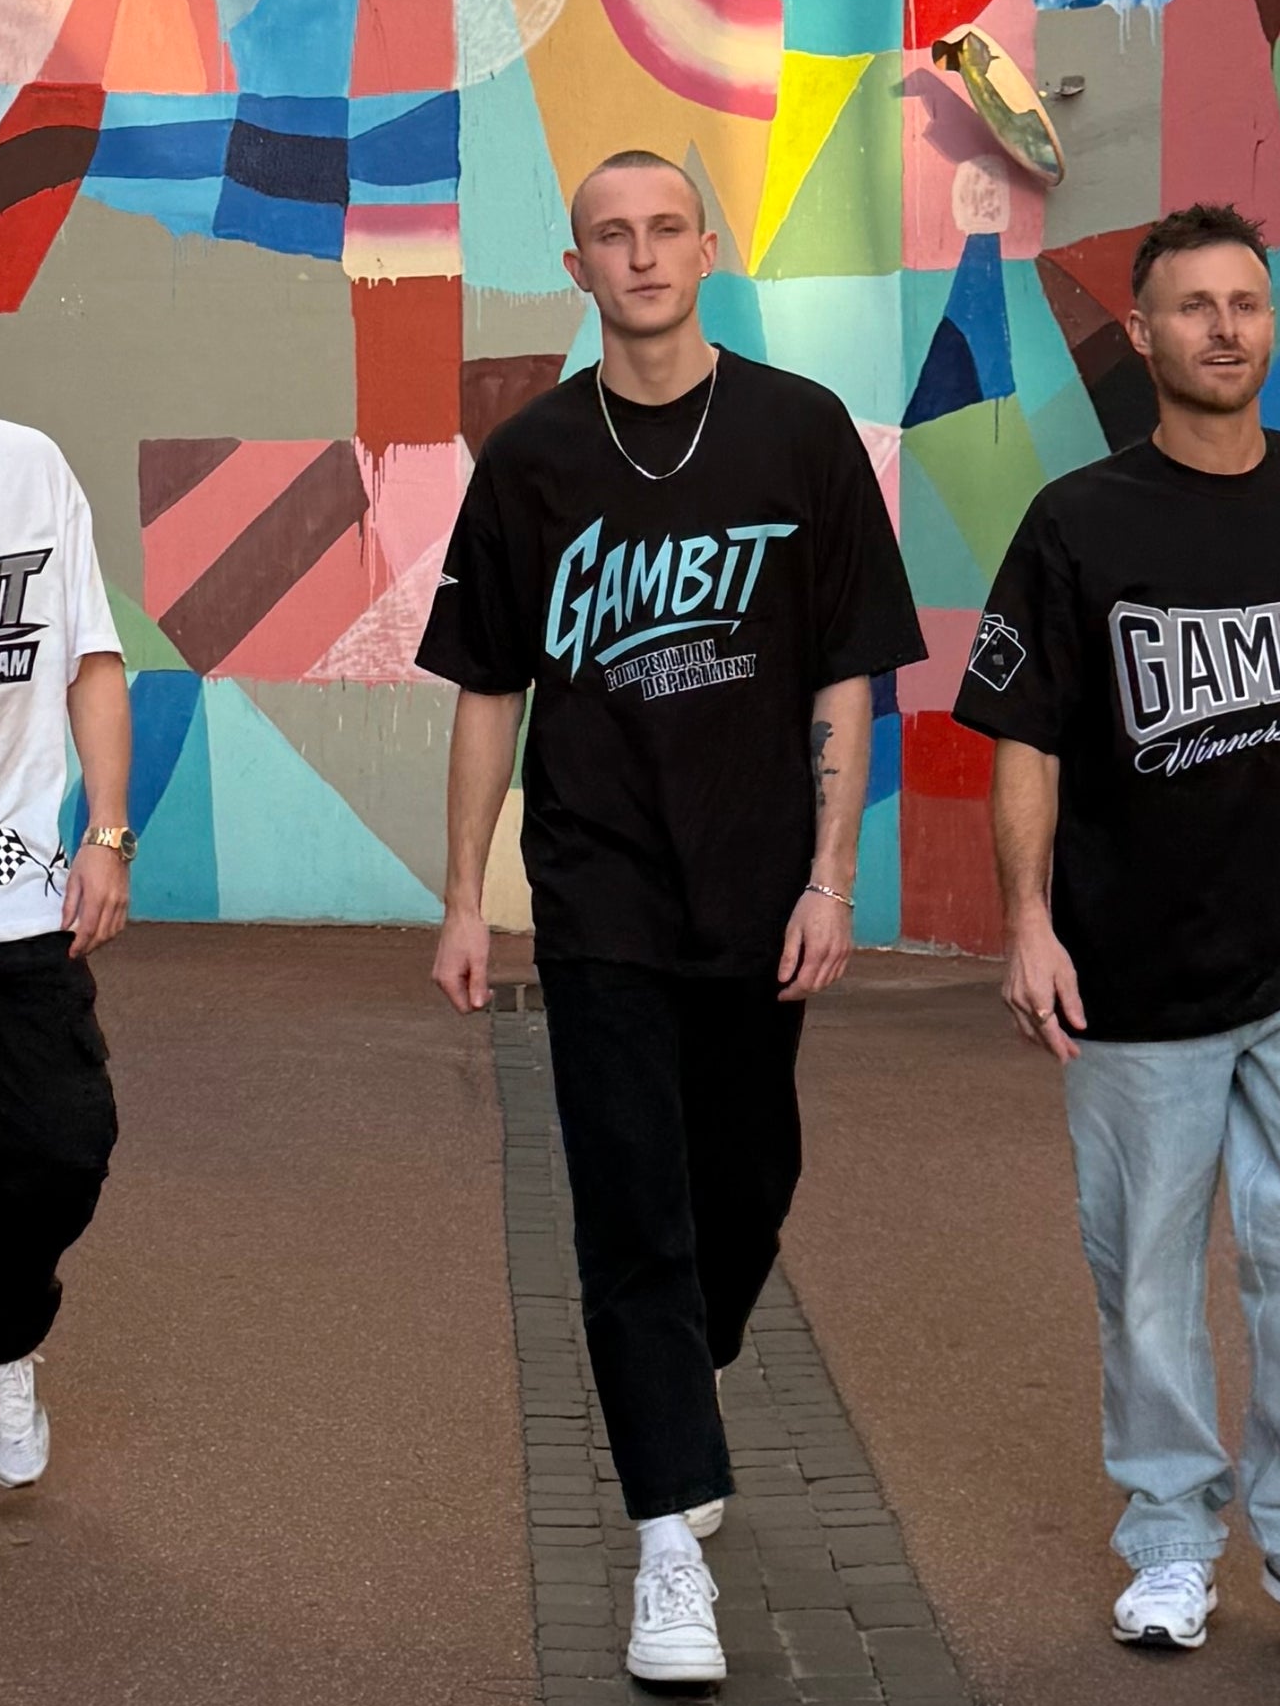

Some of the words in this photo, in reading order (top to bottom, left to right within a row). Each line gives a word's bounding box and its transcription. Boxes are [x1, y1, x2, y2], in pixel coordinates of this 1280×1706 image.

[544, 515, 799, 684] GAMBIT
[604, 638, 716, 692] COMPETITION
[640, 653, 757, 701] DEPARTMENT
